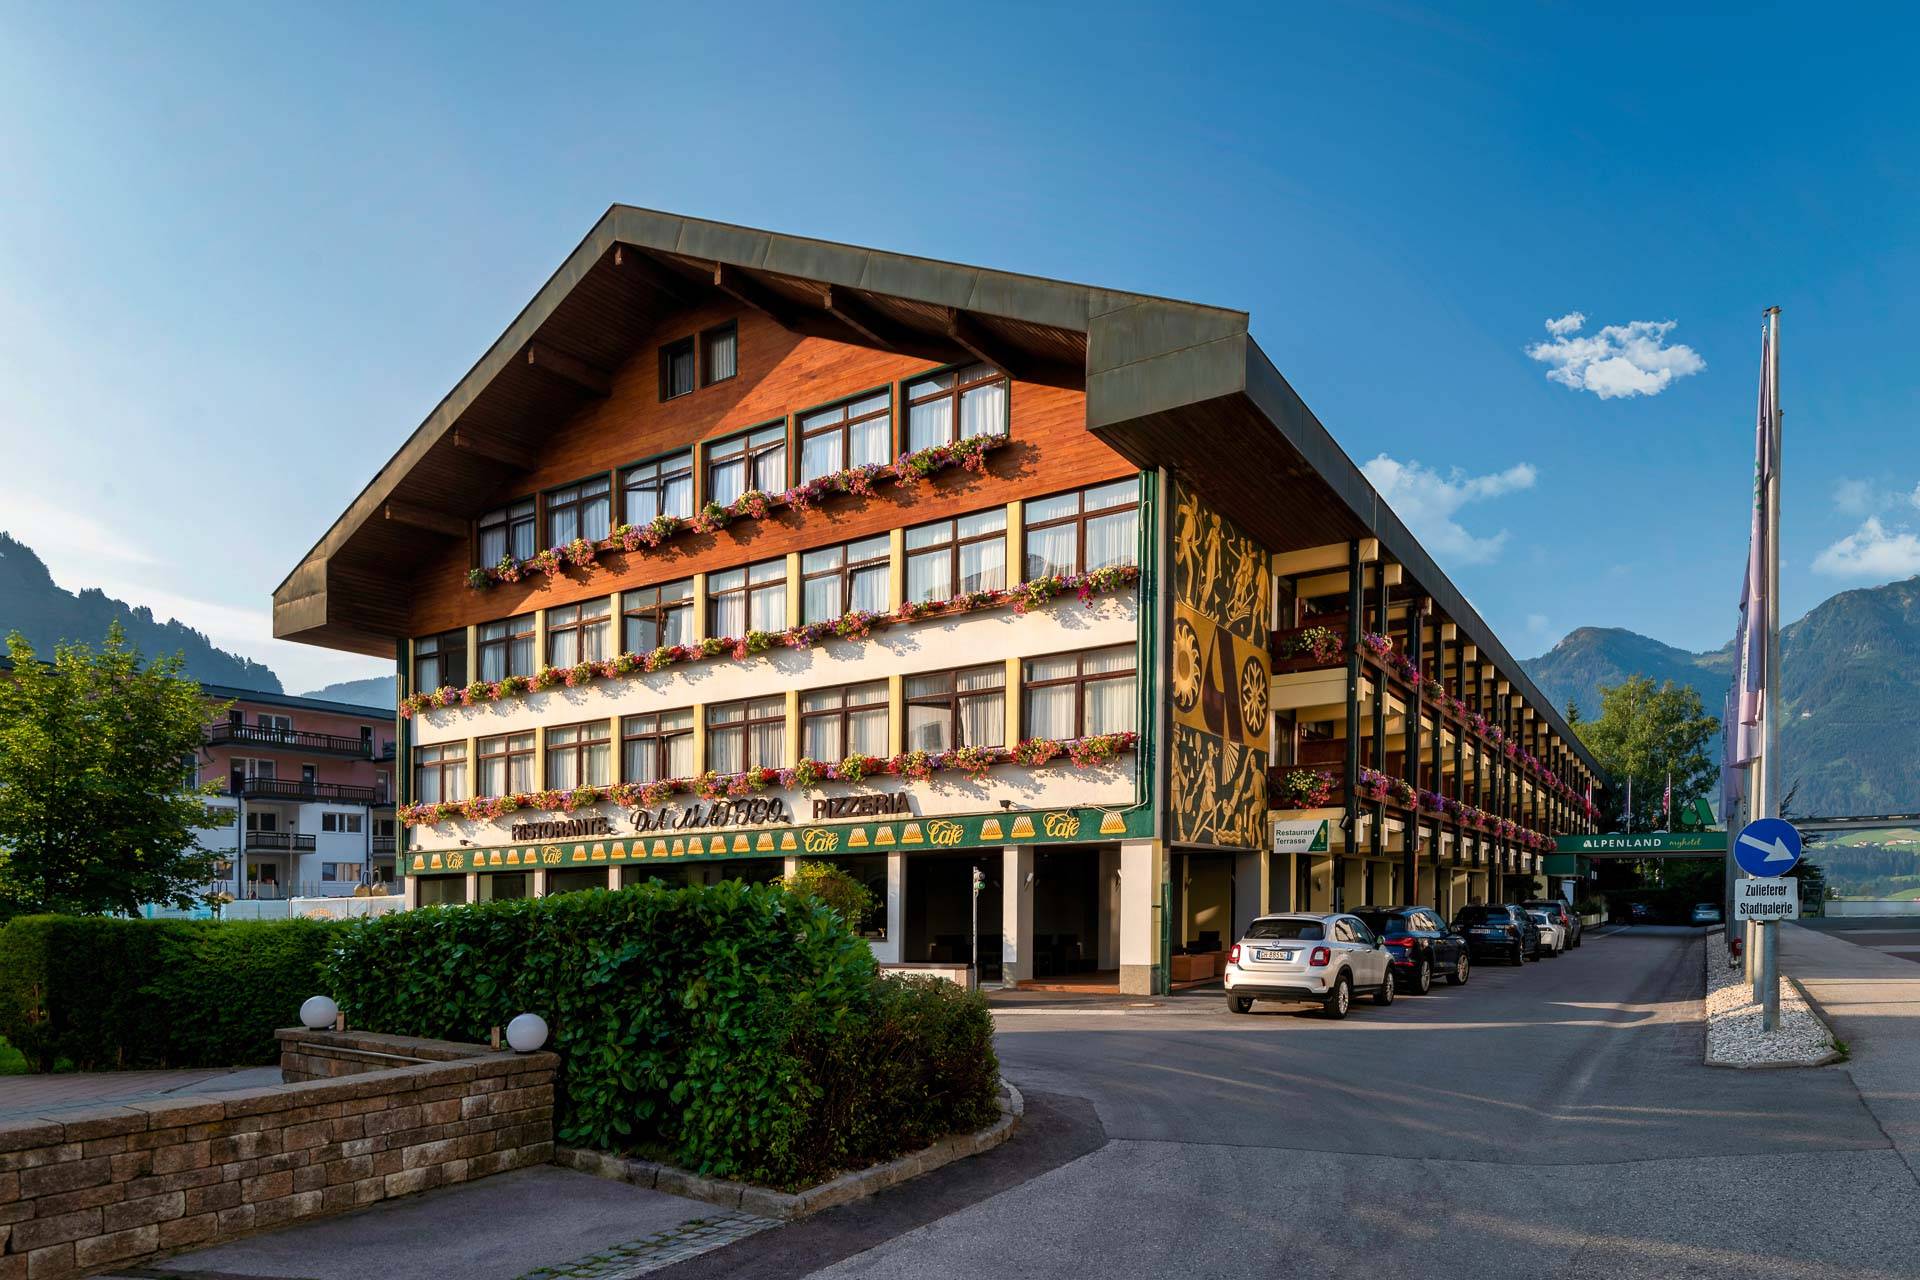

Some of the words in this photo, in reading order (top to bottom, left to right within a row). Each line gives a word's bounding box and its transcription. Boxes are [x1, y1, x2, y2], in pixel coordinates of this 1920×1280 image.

[512, 817, 607, 840] RISTORANTE
[813, 792, 911, 819] PIZZERIA
[1276, 837, 1307, 845] Terrasse
[1745, 884, 1787, 897] Zulieferer
[1740, 902, 1793, 916] Stadtgalerie
